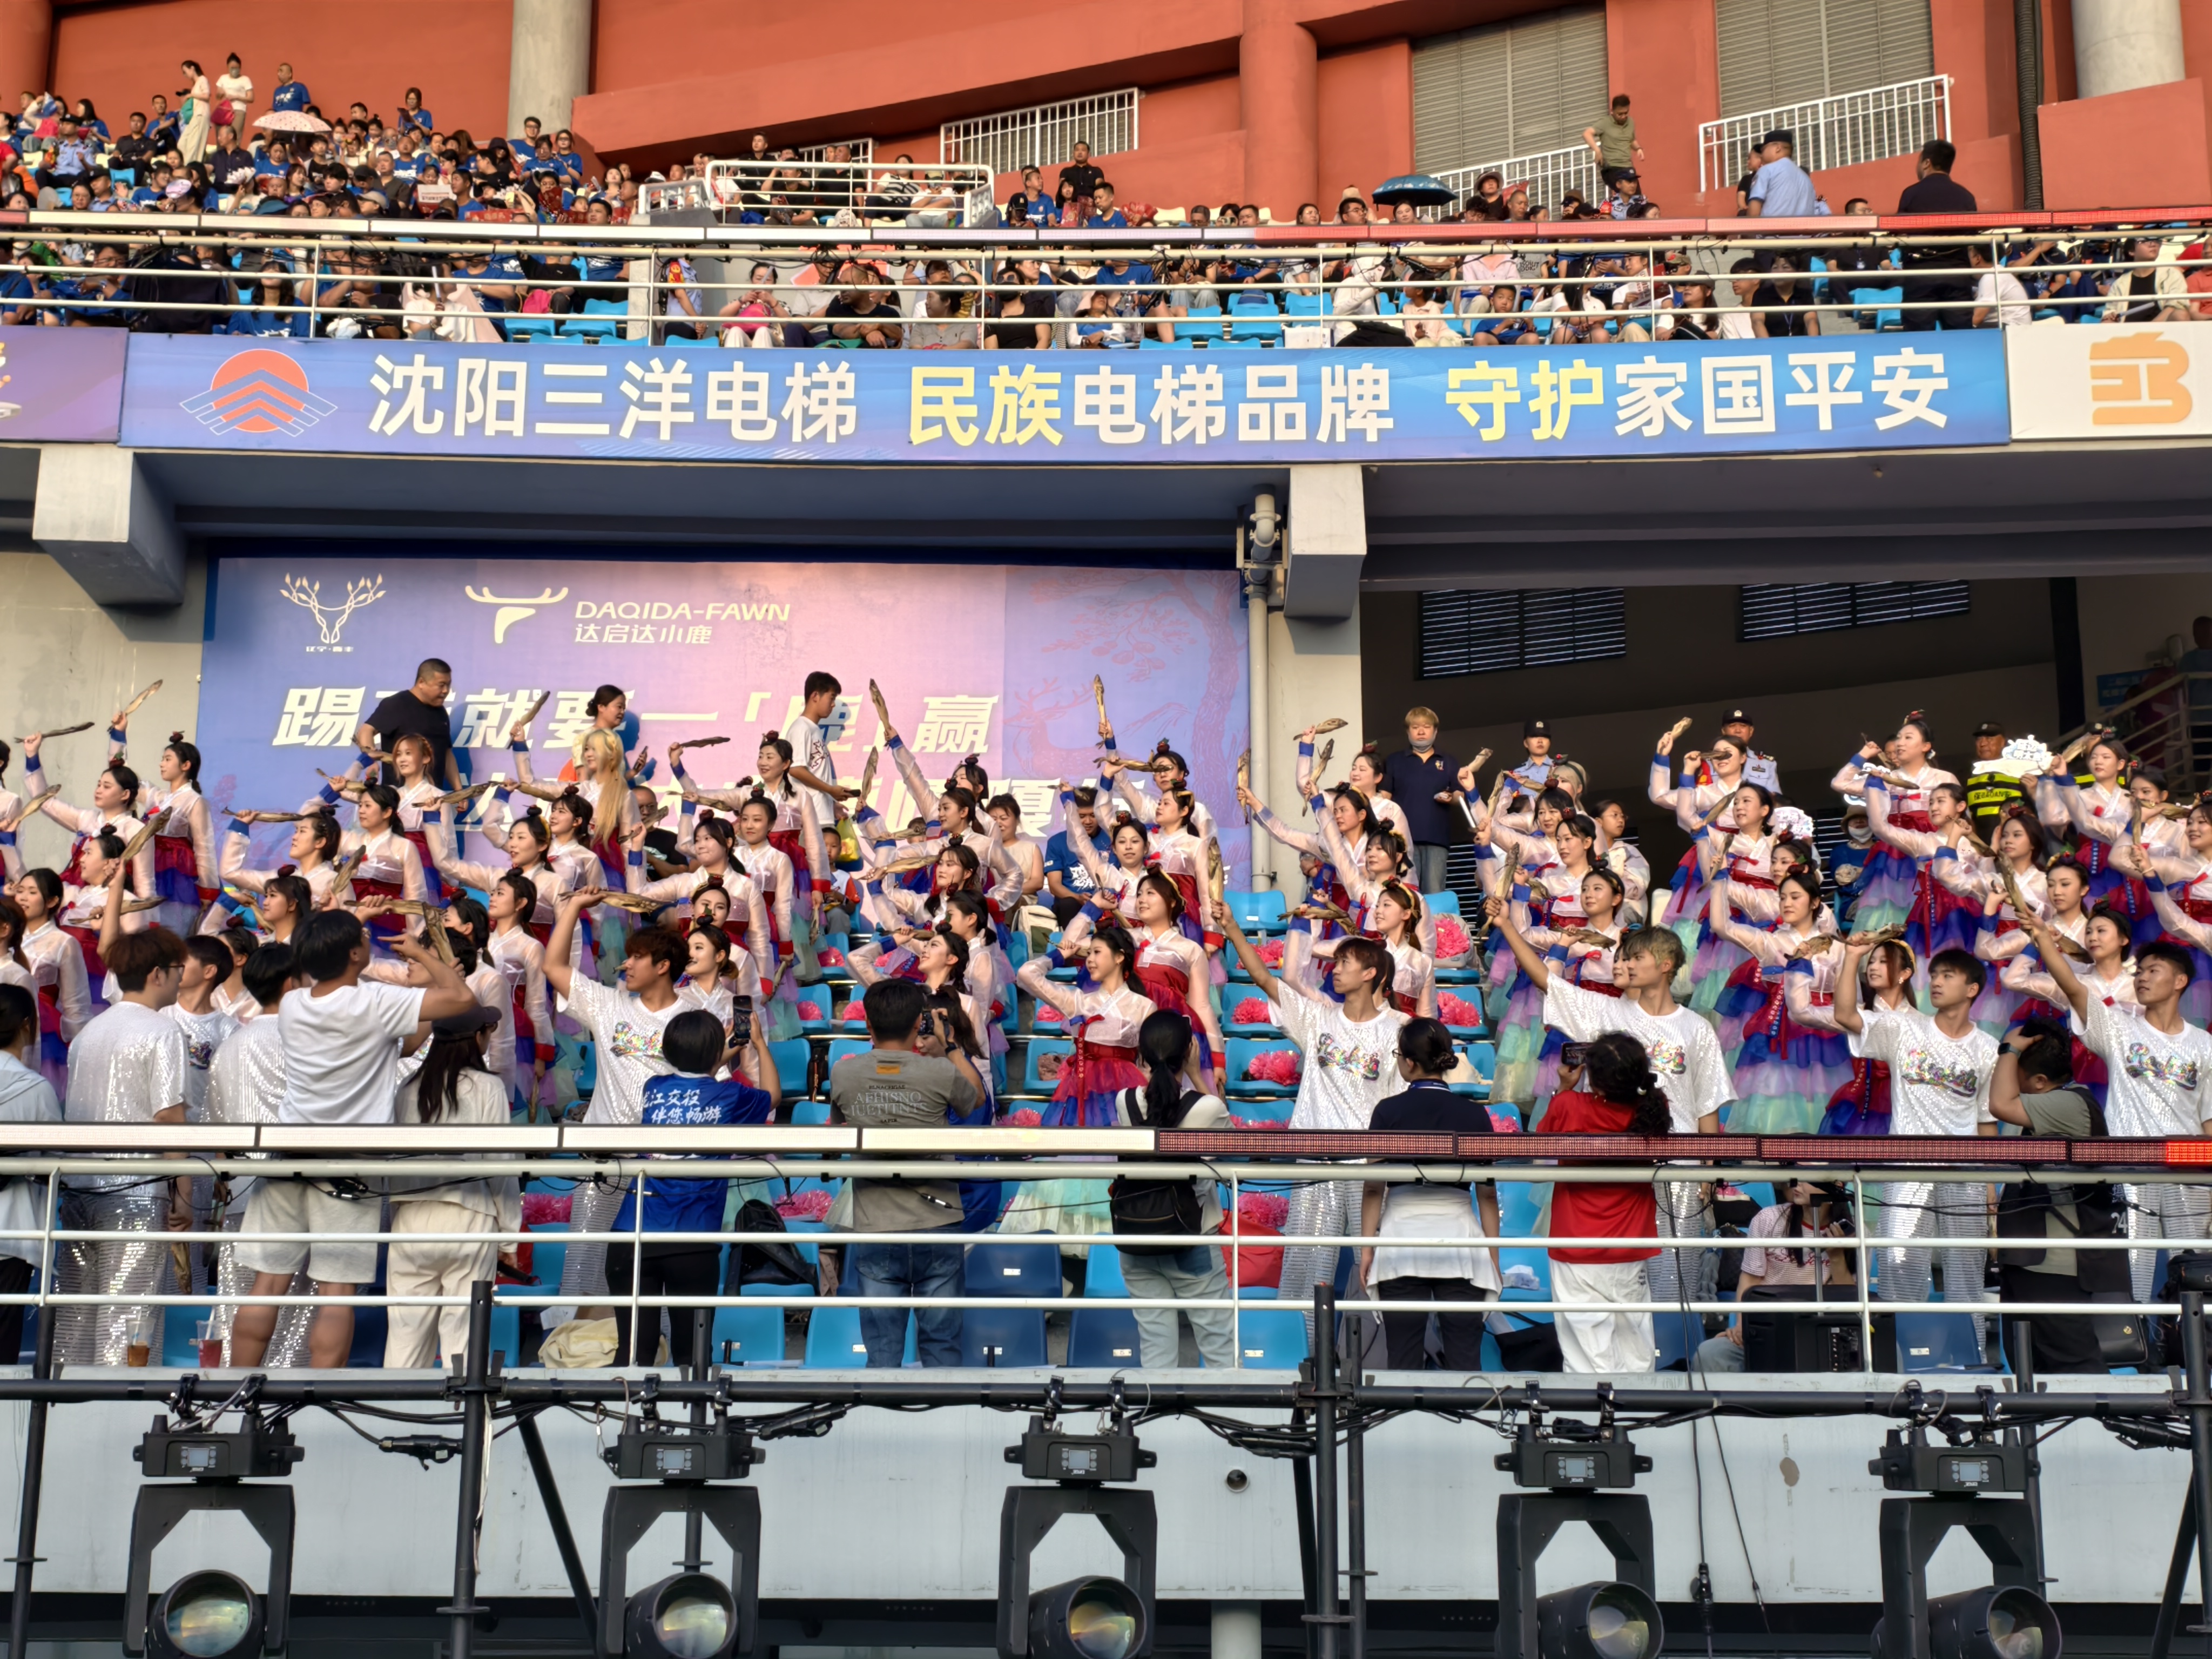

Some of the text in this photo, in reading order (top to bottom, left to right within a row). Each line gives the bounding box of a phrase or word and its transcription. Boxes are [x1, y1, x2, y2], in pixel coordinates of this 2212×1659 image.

[369, 346, 1948, 446] 沈阳三洋电梯 民族电梯品牌 守护家国平安
[575, 601, 790, 621] DAQIDA-FAWN
[575, 623, 712, 644] 达启达小鹿
[651, 1105, 723, 1124] 伴您畅游
